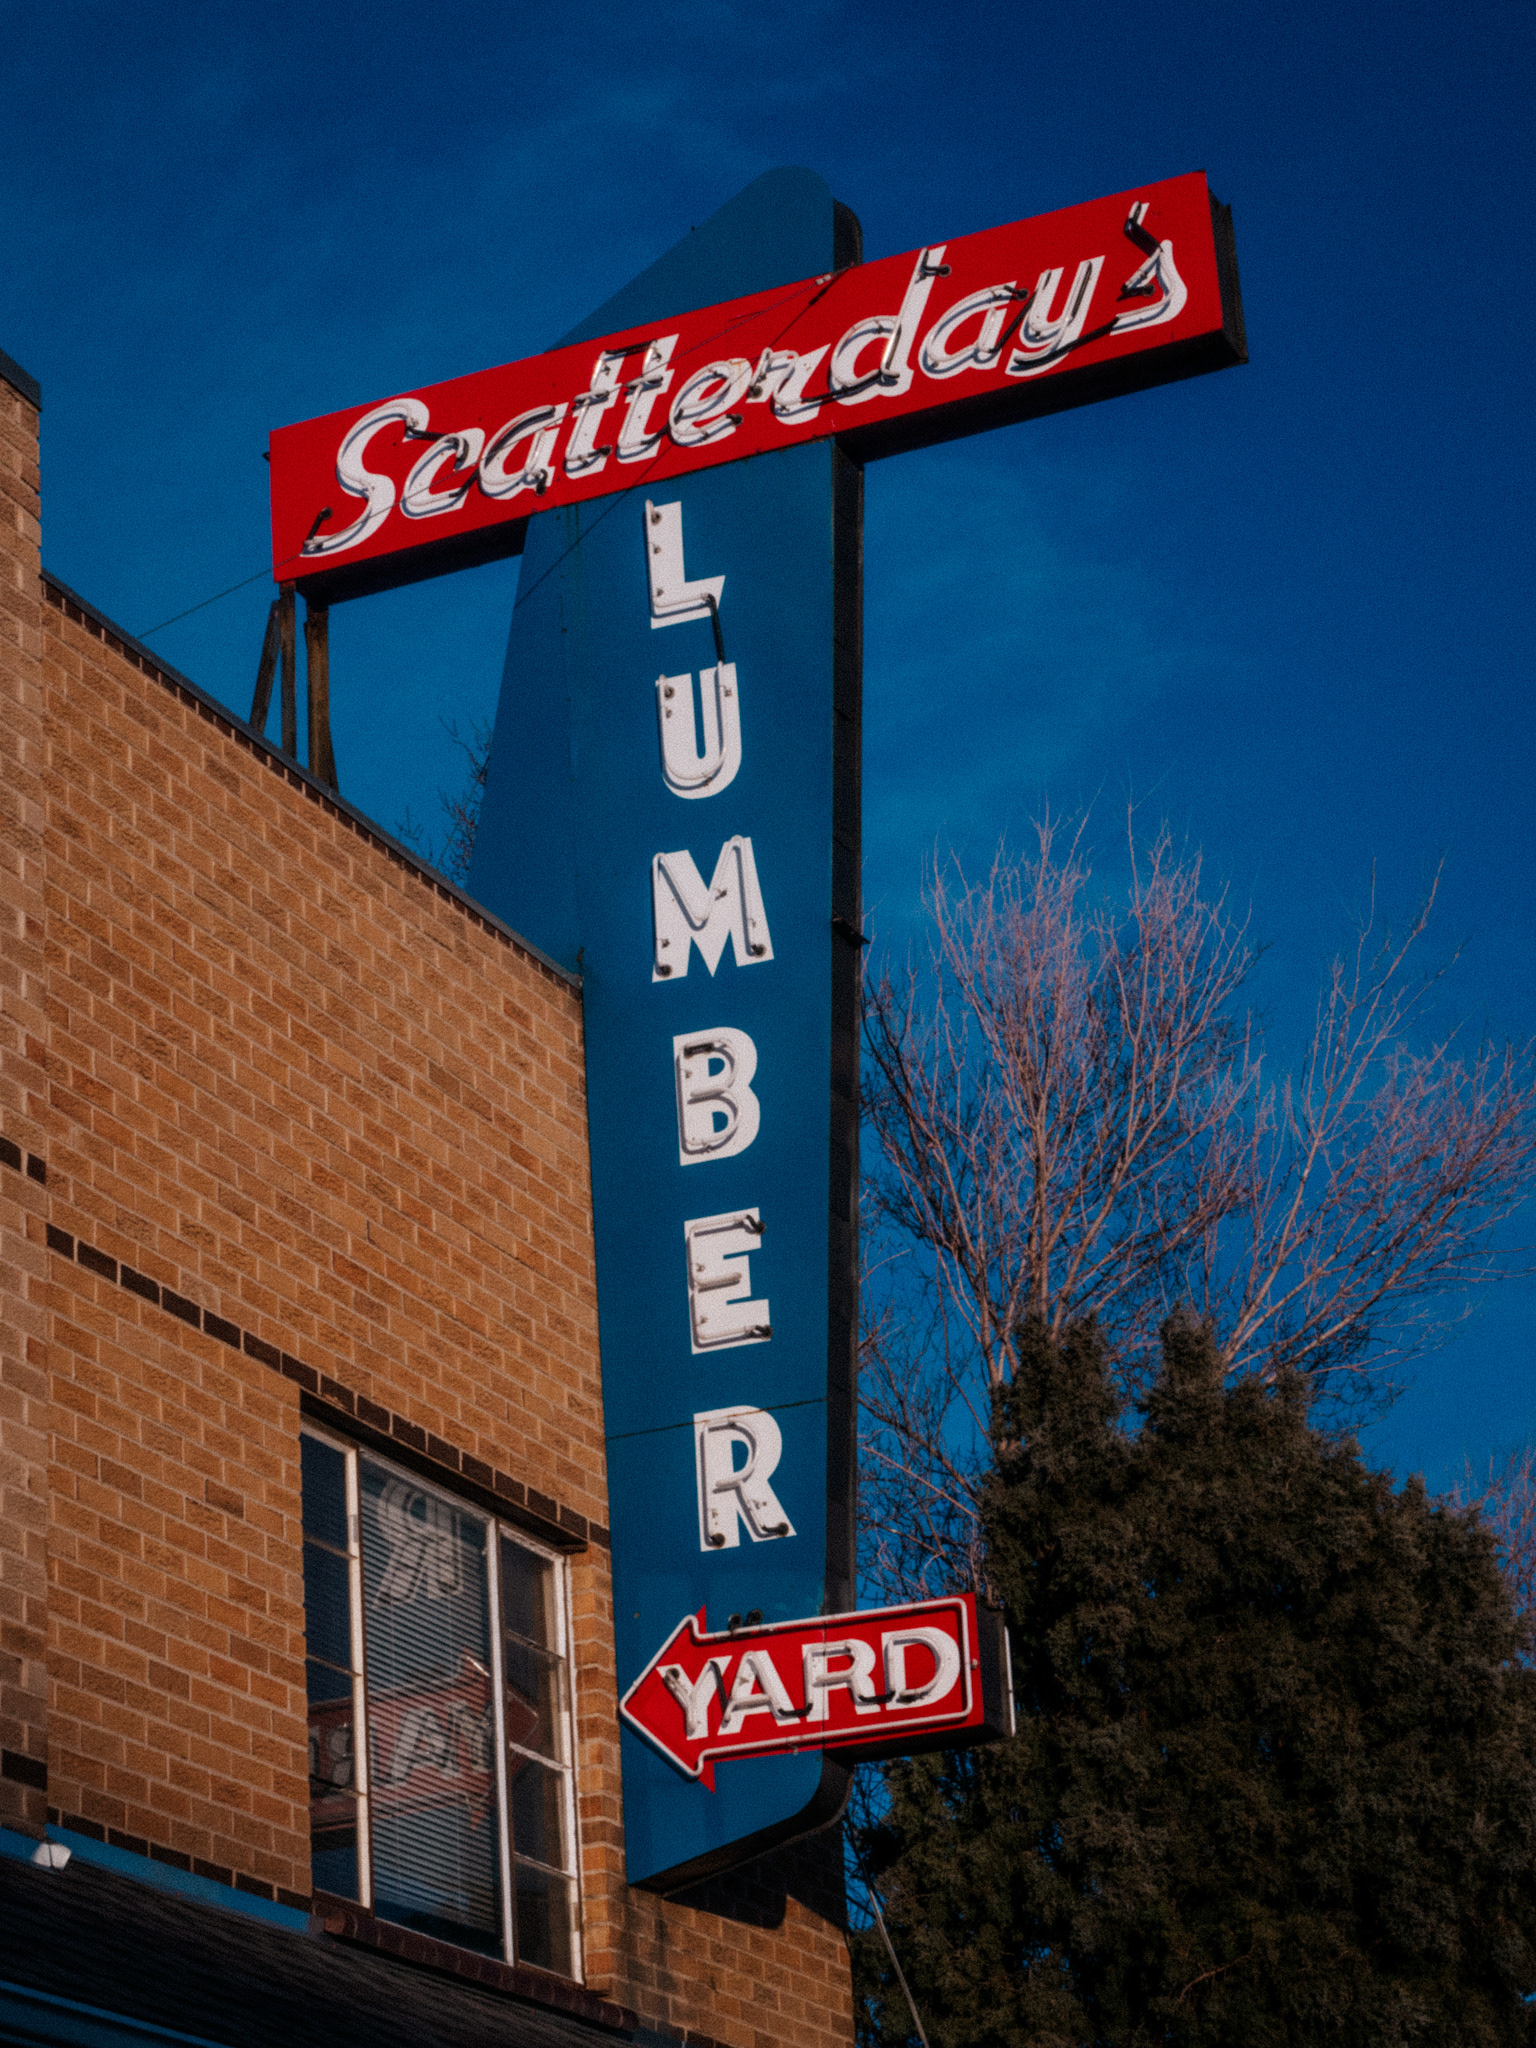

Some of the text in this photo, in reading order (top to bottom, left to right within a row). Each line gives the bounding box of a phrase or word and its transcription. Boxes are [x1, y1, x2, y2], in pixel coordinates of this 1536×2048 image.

[299, 202, 1187, 557] Scatterday's
[644, 499, 797, 1552] LUMBER
[655, 1626, 961, 1741] YARD
